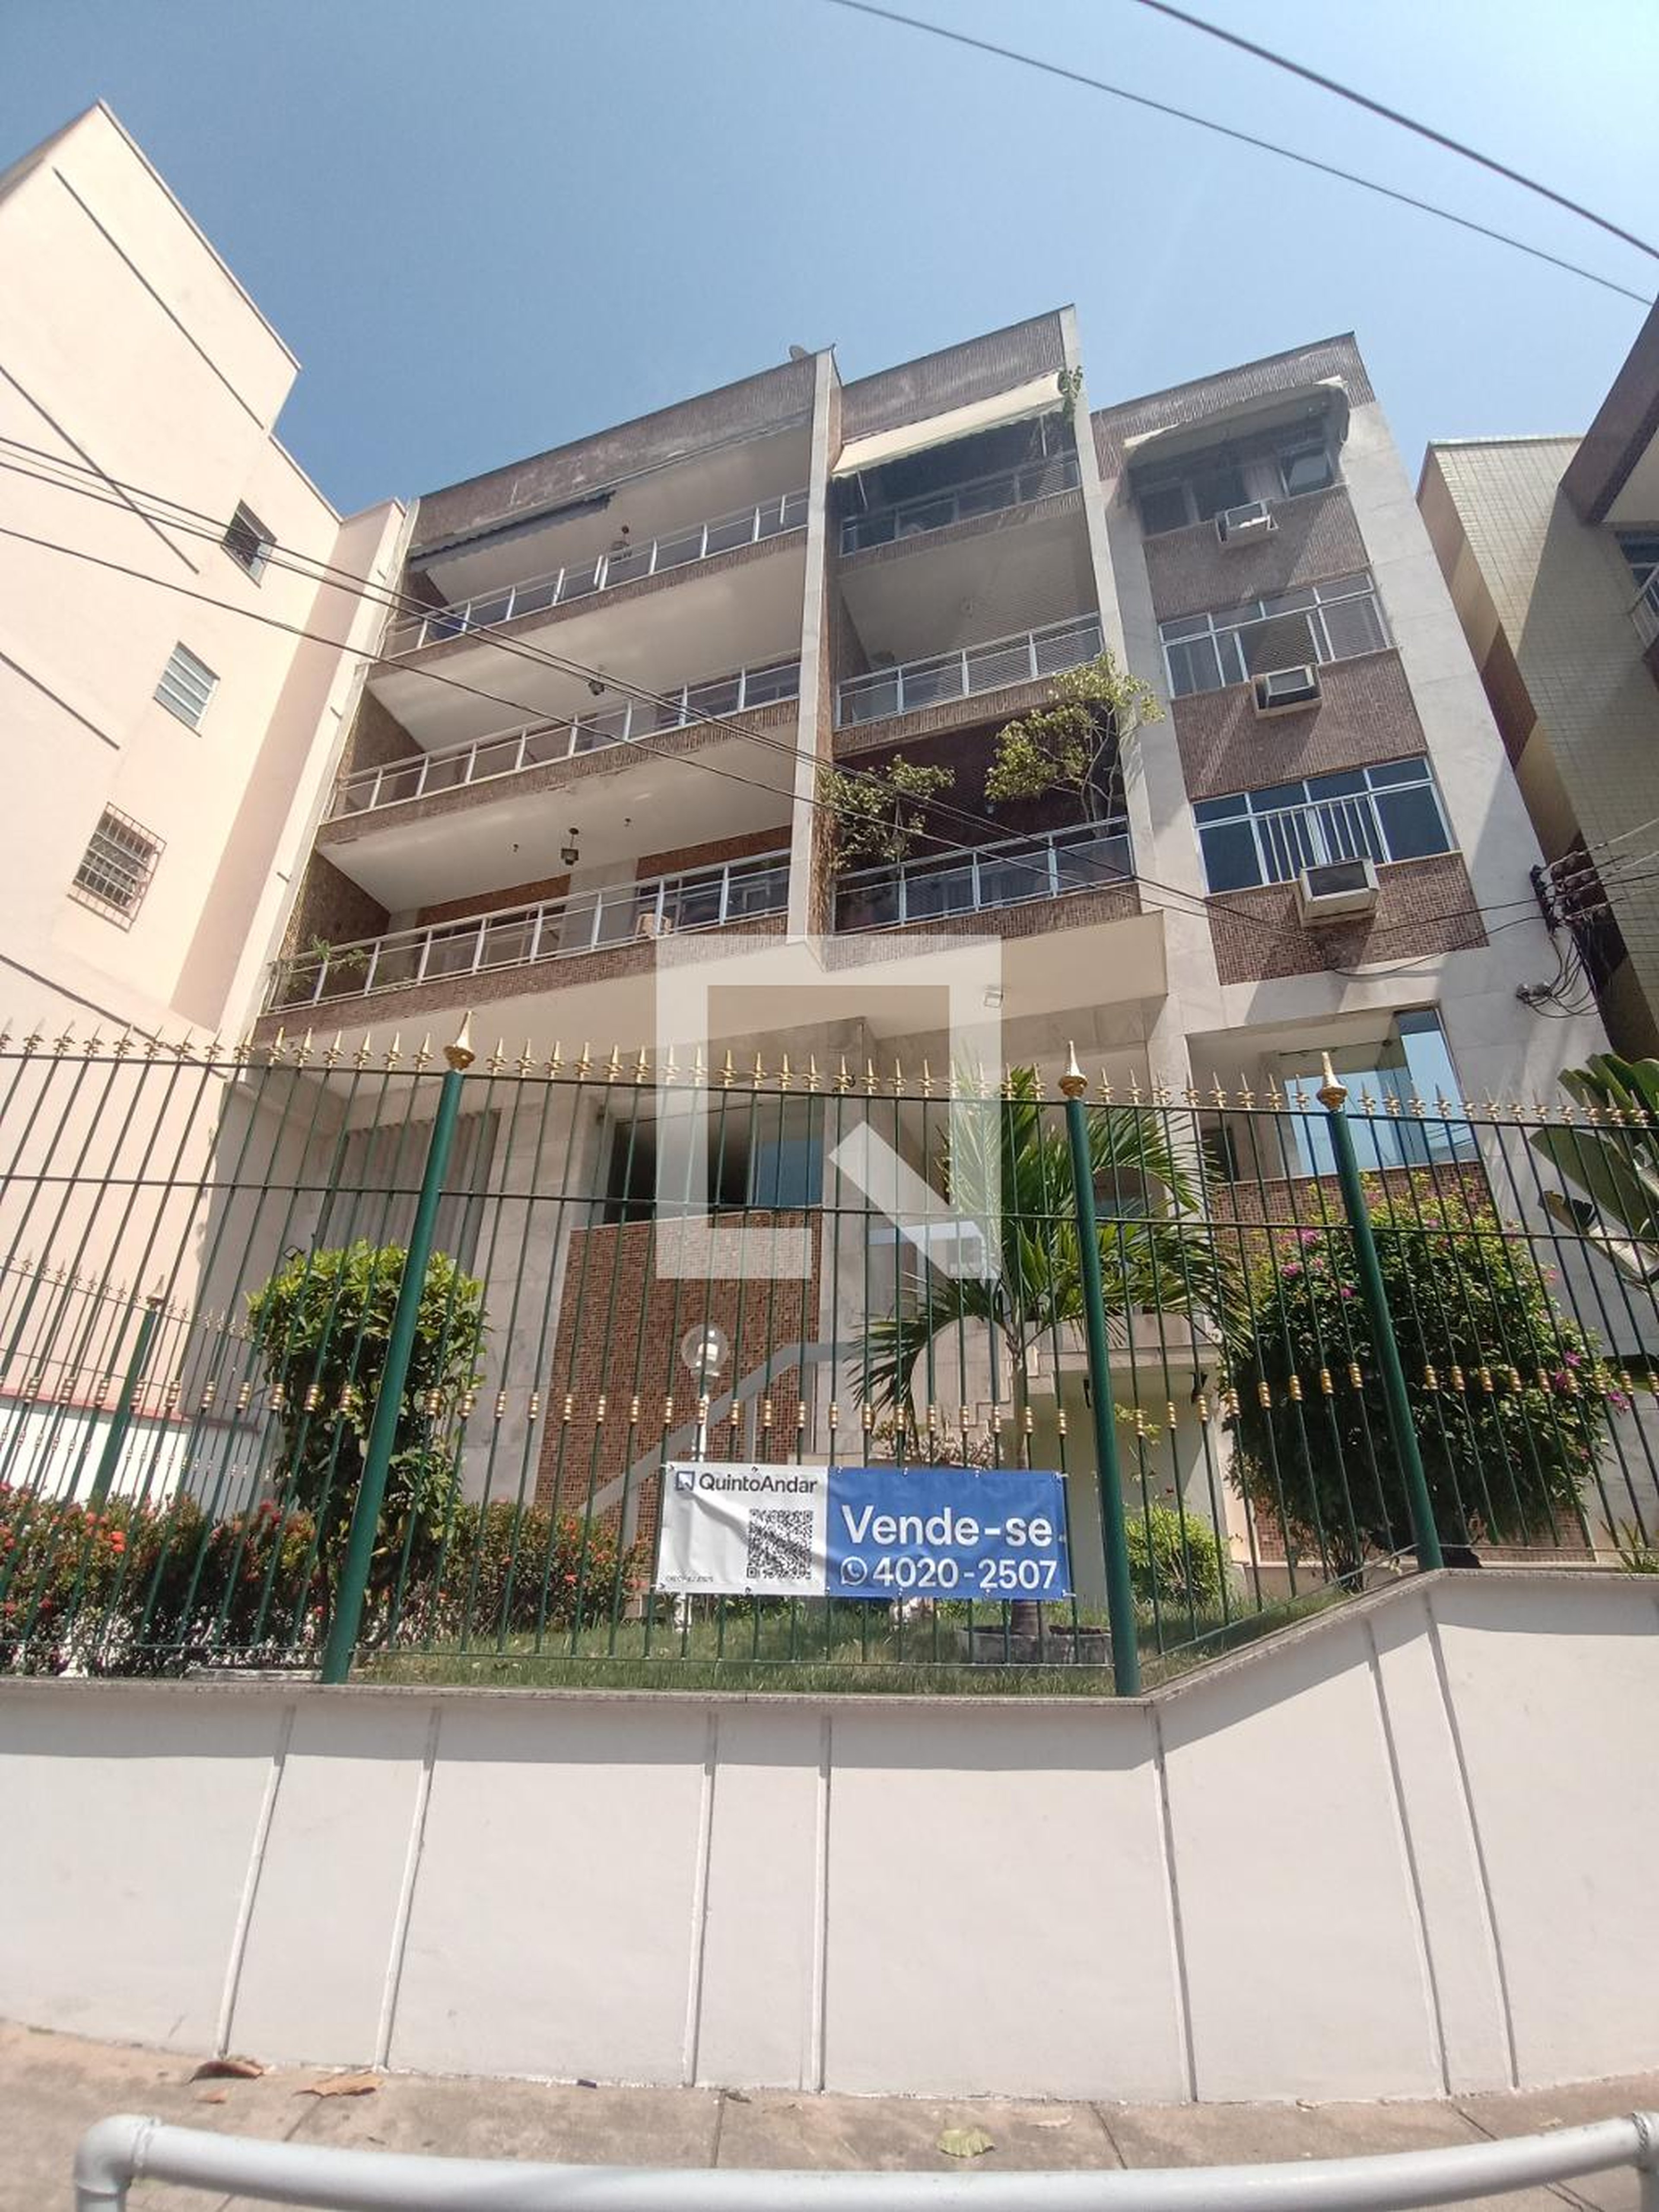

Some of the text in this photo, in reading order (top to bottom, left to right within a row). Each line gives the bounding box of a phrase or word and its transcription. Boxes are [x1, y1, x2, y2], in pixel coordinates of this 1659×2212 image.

[699, 1473, 818, 1493] QuintoAndar
[842, 1505, 1052, 1547] Vende-se
[873, 1557, 1057, 1589] 4020-2507
